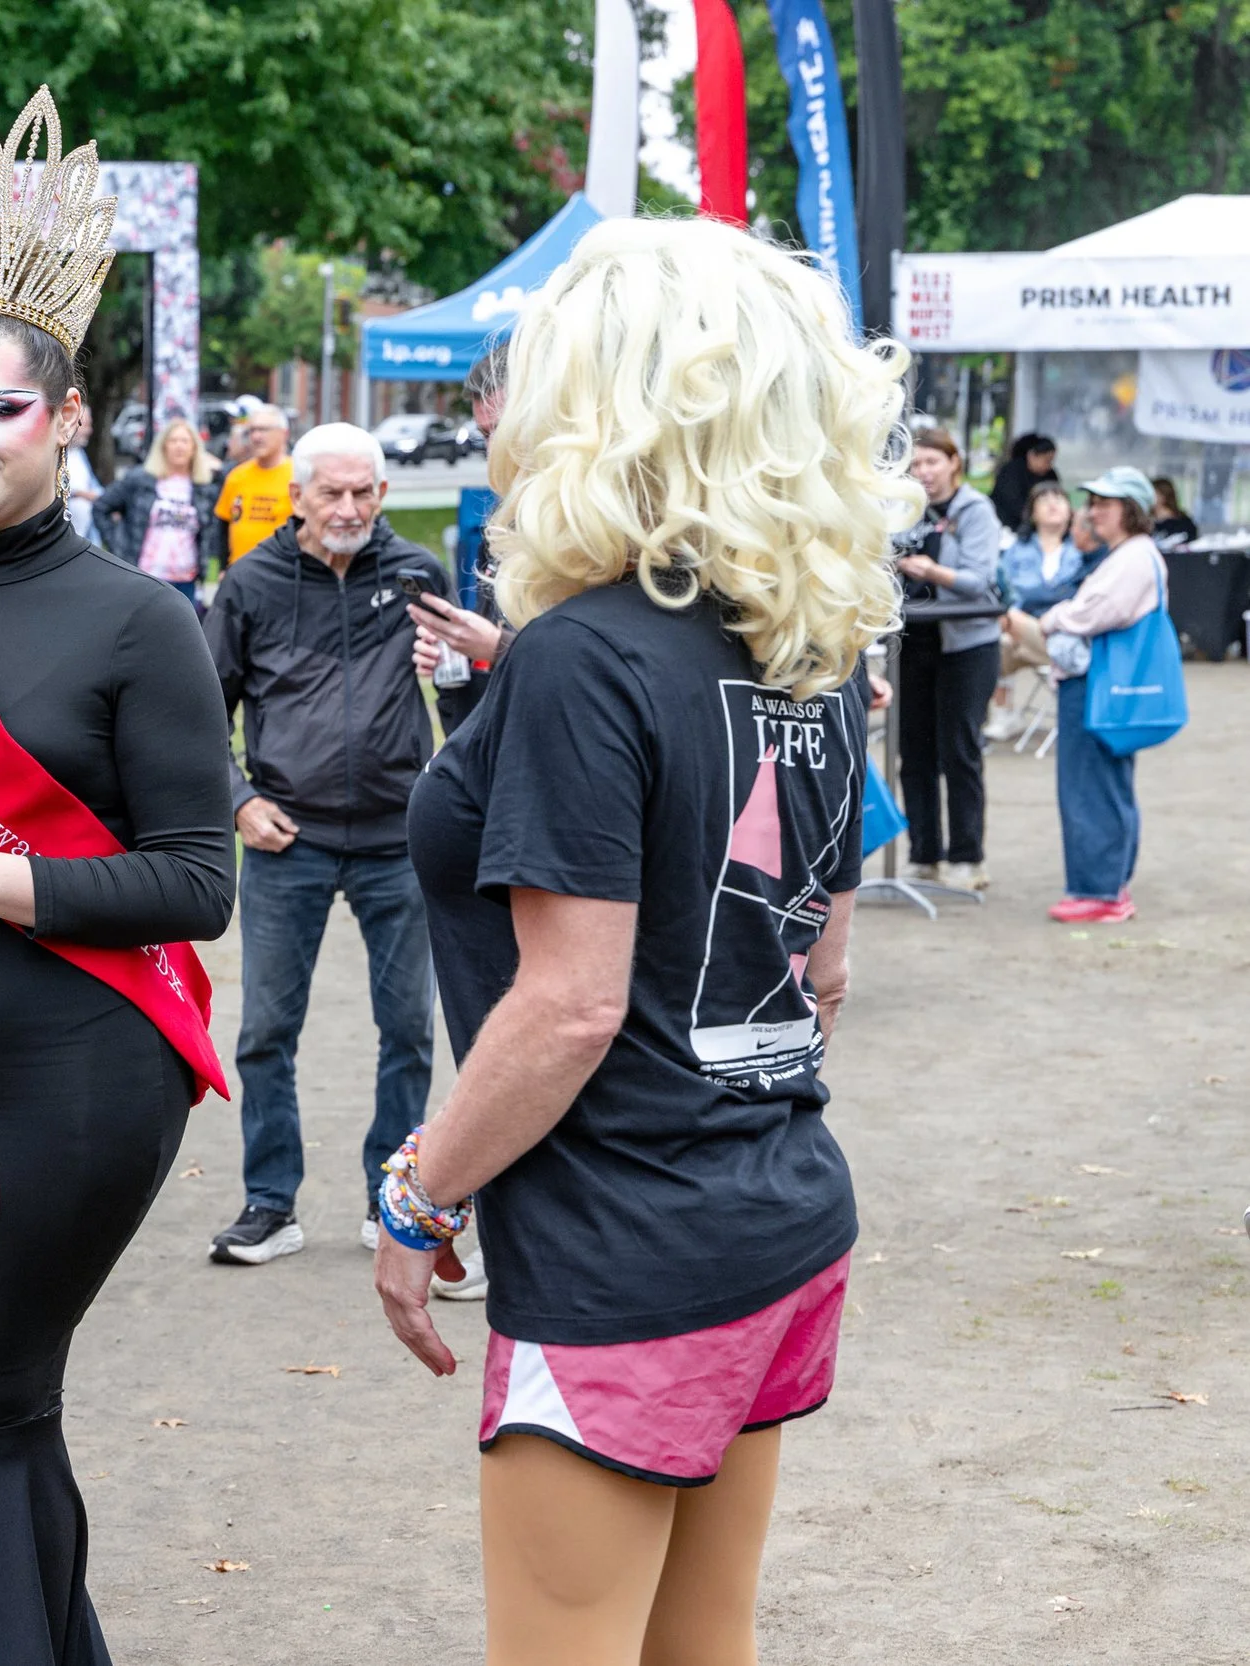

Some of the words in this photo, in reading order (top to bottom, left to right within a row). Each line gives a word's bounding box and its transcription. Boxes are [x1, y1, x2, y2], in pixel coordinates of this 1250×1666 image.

[1020, 285, 1111, 309] PRISM
[1121, 283, 1232, 308] HEALTH
[805, 703, 825, 719] OF
[752, 715, 827, 770] LFE
